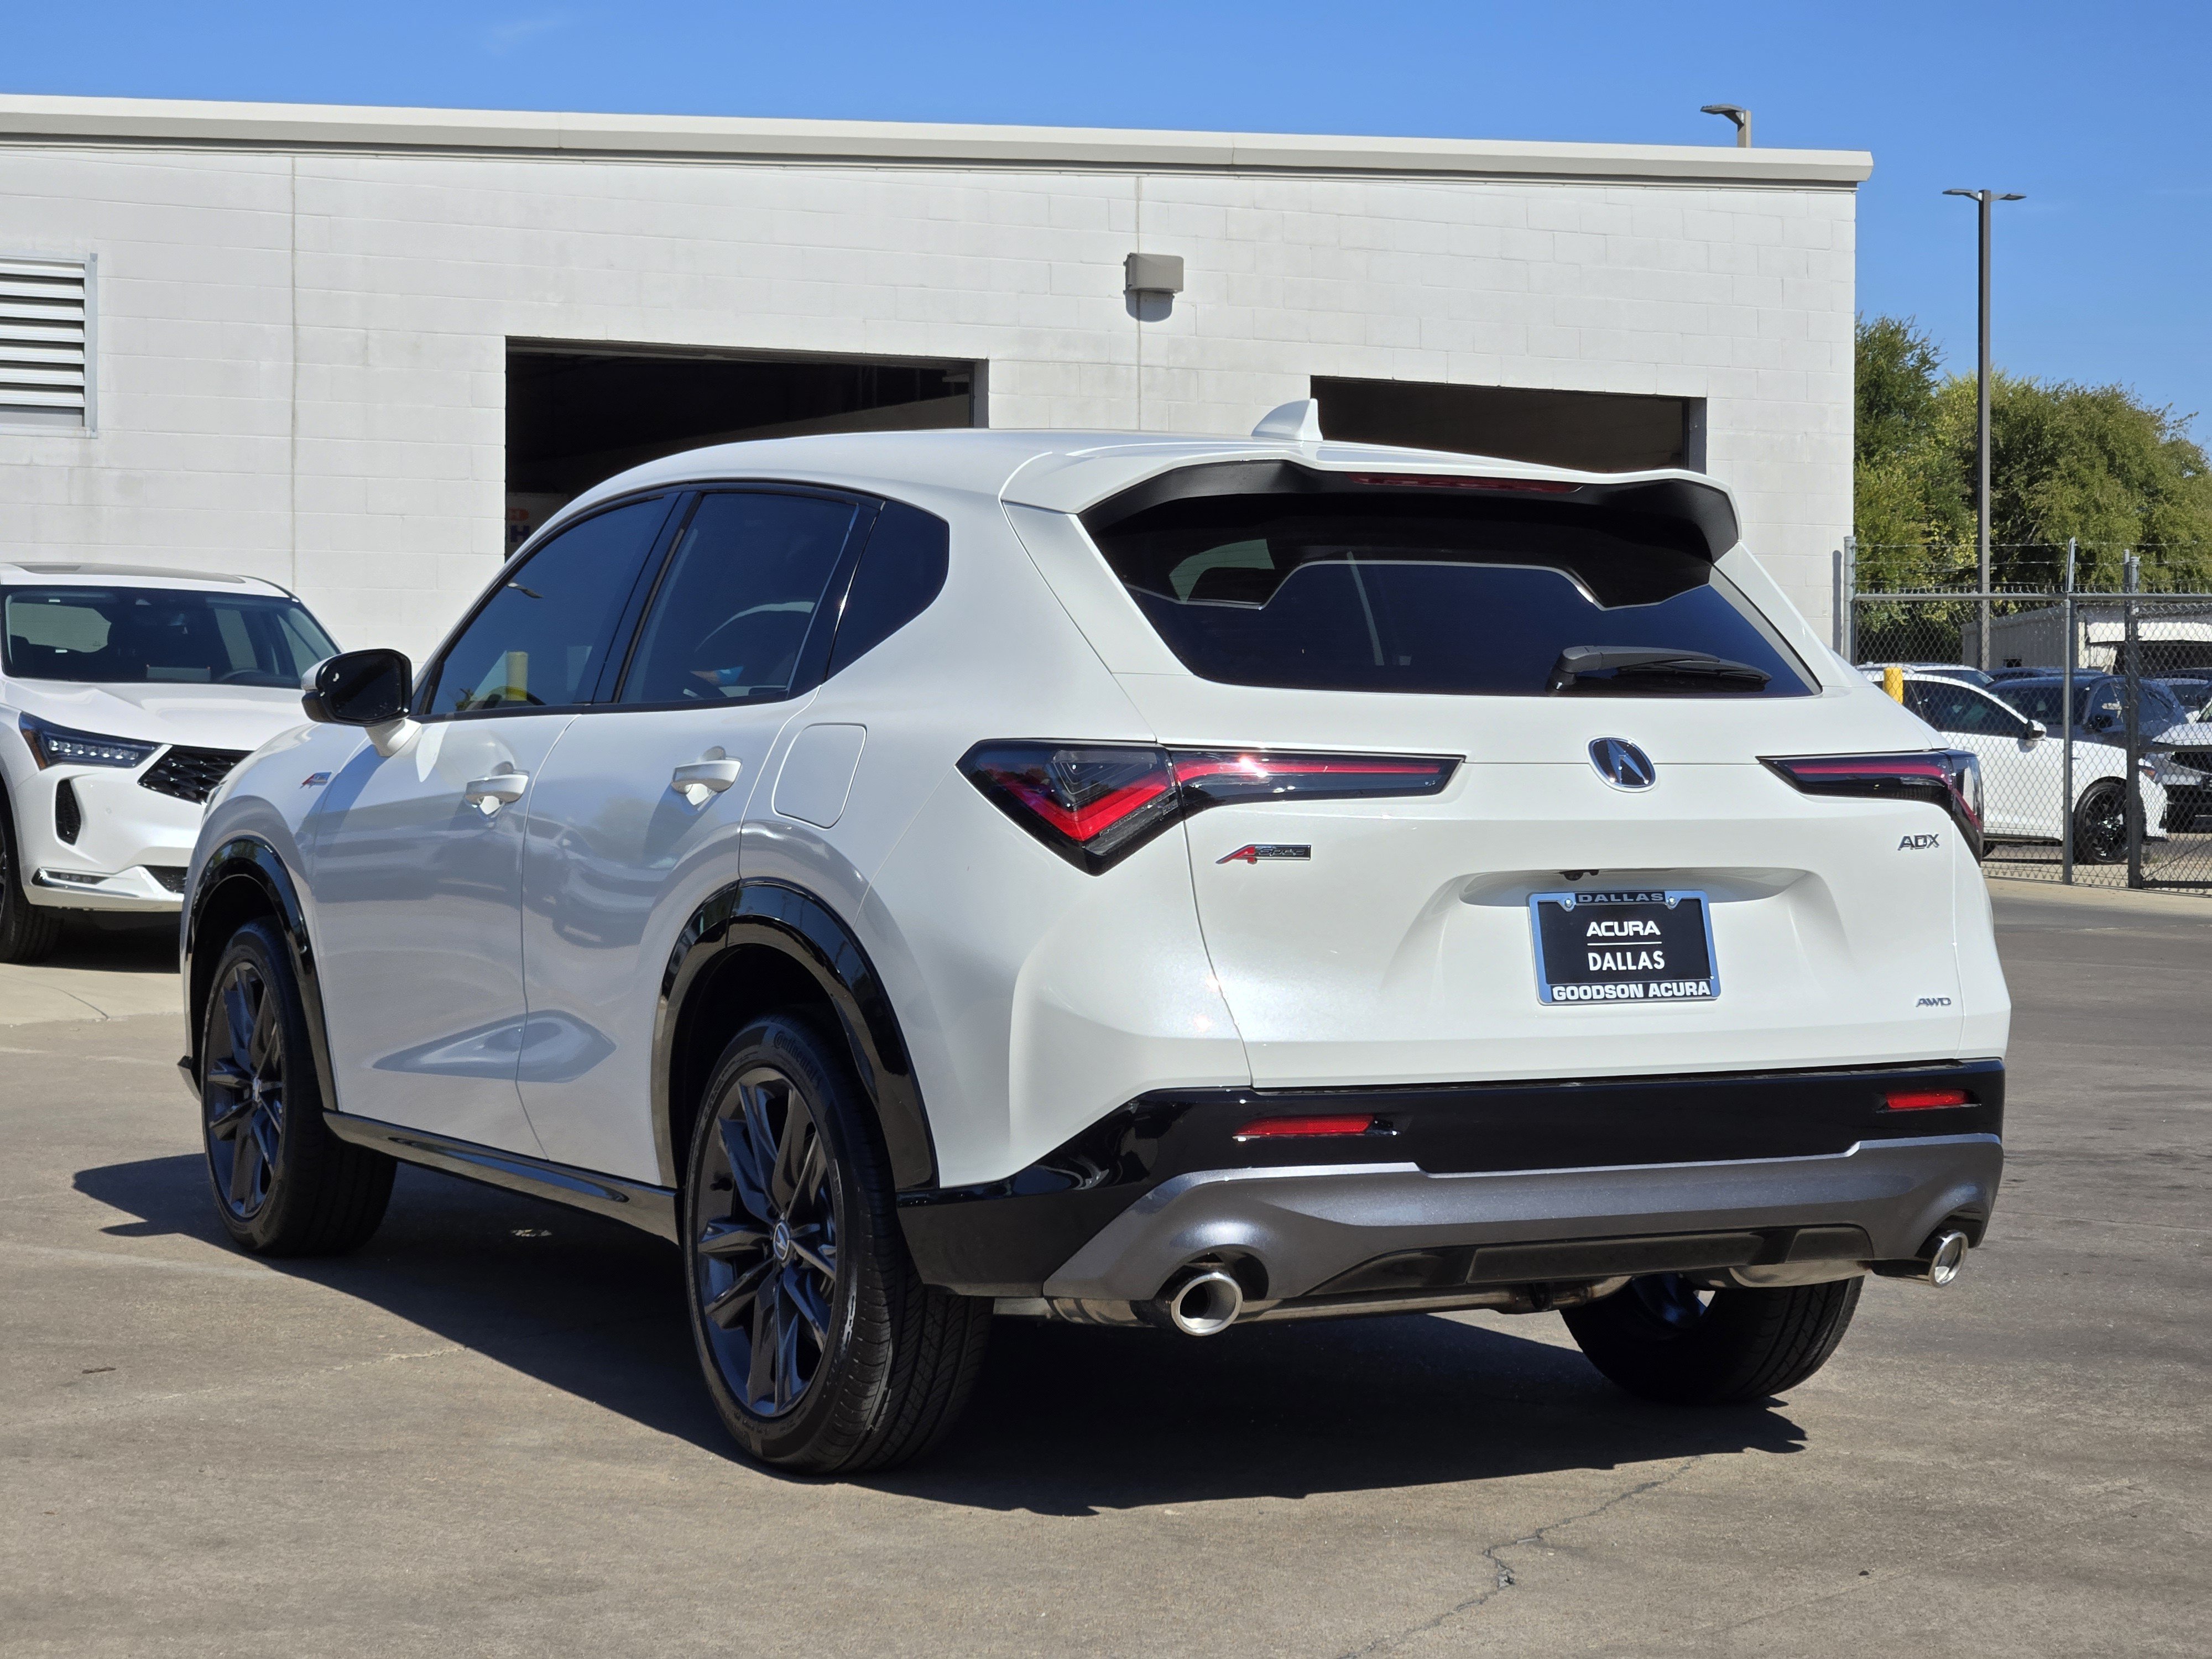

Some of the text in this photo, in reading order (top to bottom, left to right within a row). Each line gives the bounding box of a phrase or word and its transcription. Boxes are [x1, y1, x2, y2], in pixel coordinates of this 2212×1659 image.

[1897, 833, 1940, 851] ADX
[1578, 892, 1665, 902] DALLAS
[1586, 921, 1661, 937] ACURA
[1588, 951, 1666, 971] DALLAS
[1552, 981, 1711, 1001] GOODSON ACURA
[1915, 997, 1952, 1008] AWD
